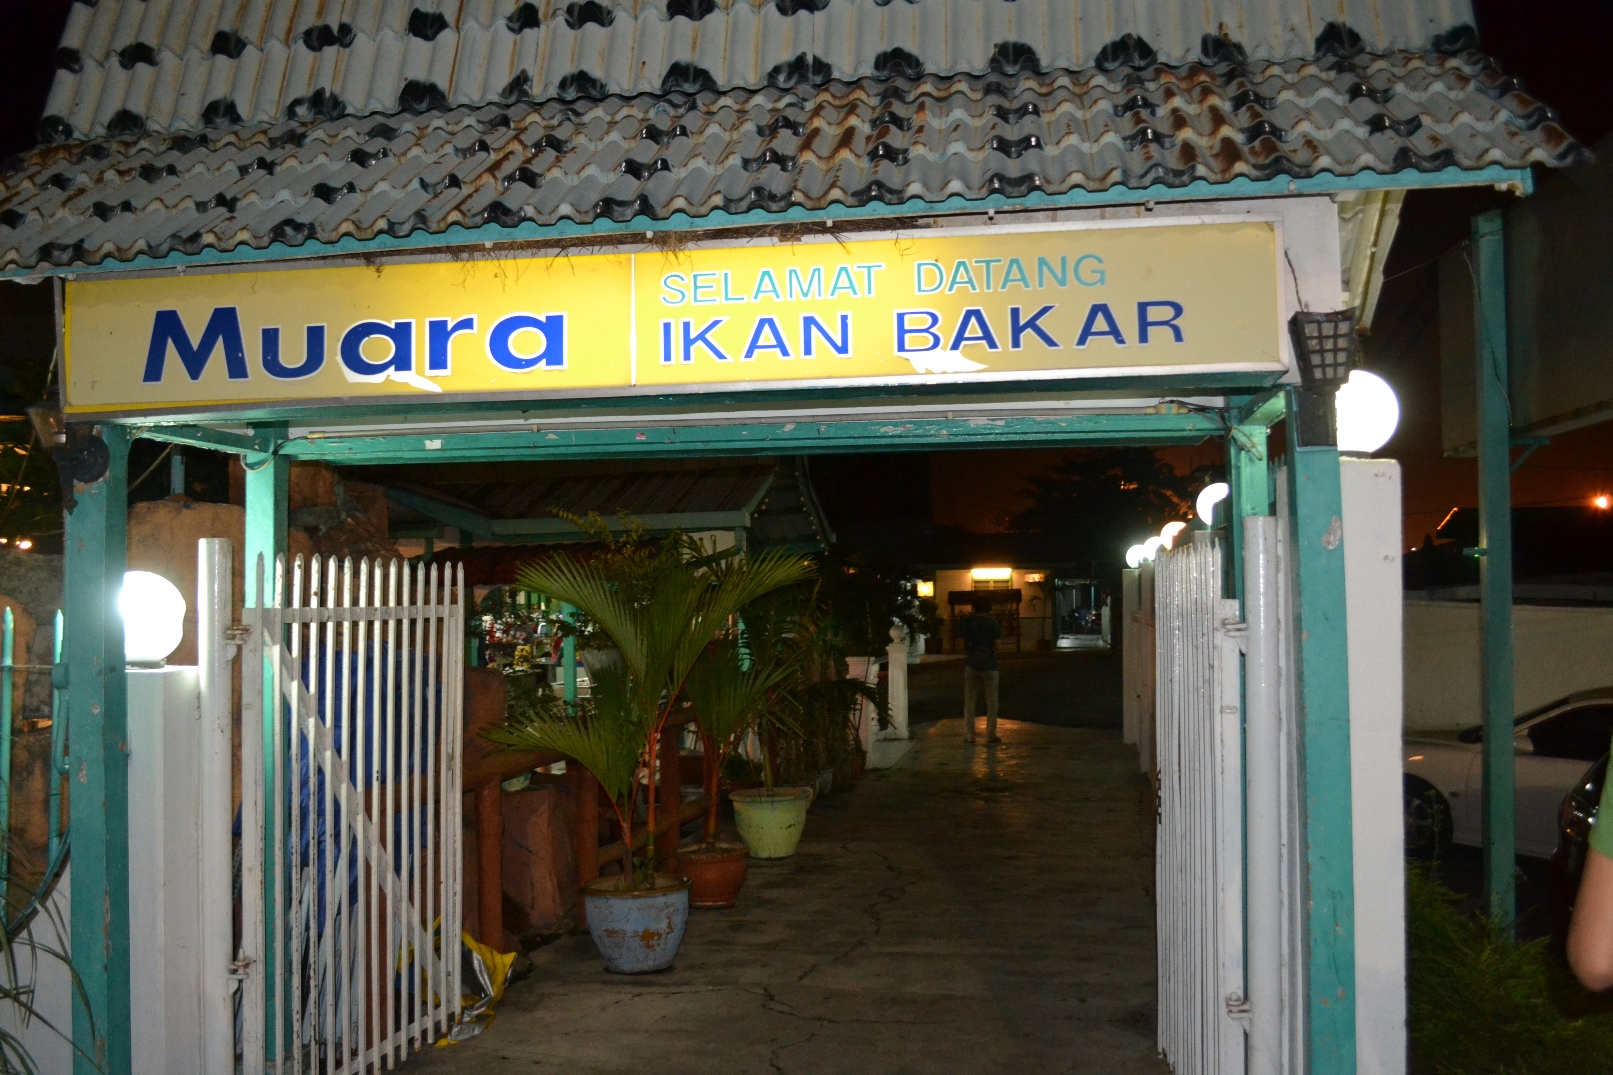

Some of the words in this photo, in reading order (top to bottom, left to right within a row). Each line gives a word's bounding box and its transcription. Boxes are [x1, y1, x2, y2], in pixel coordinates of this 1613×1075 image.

[661, 263, 883, 305] SELAMAT
[915, 254, 1107, 295] DATANG
[142, 306, 567, 384] Muara
[660, 312, 851, 364] IKAN
[896, 300, 1185, 354] BAKAR
